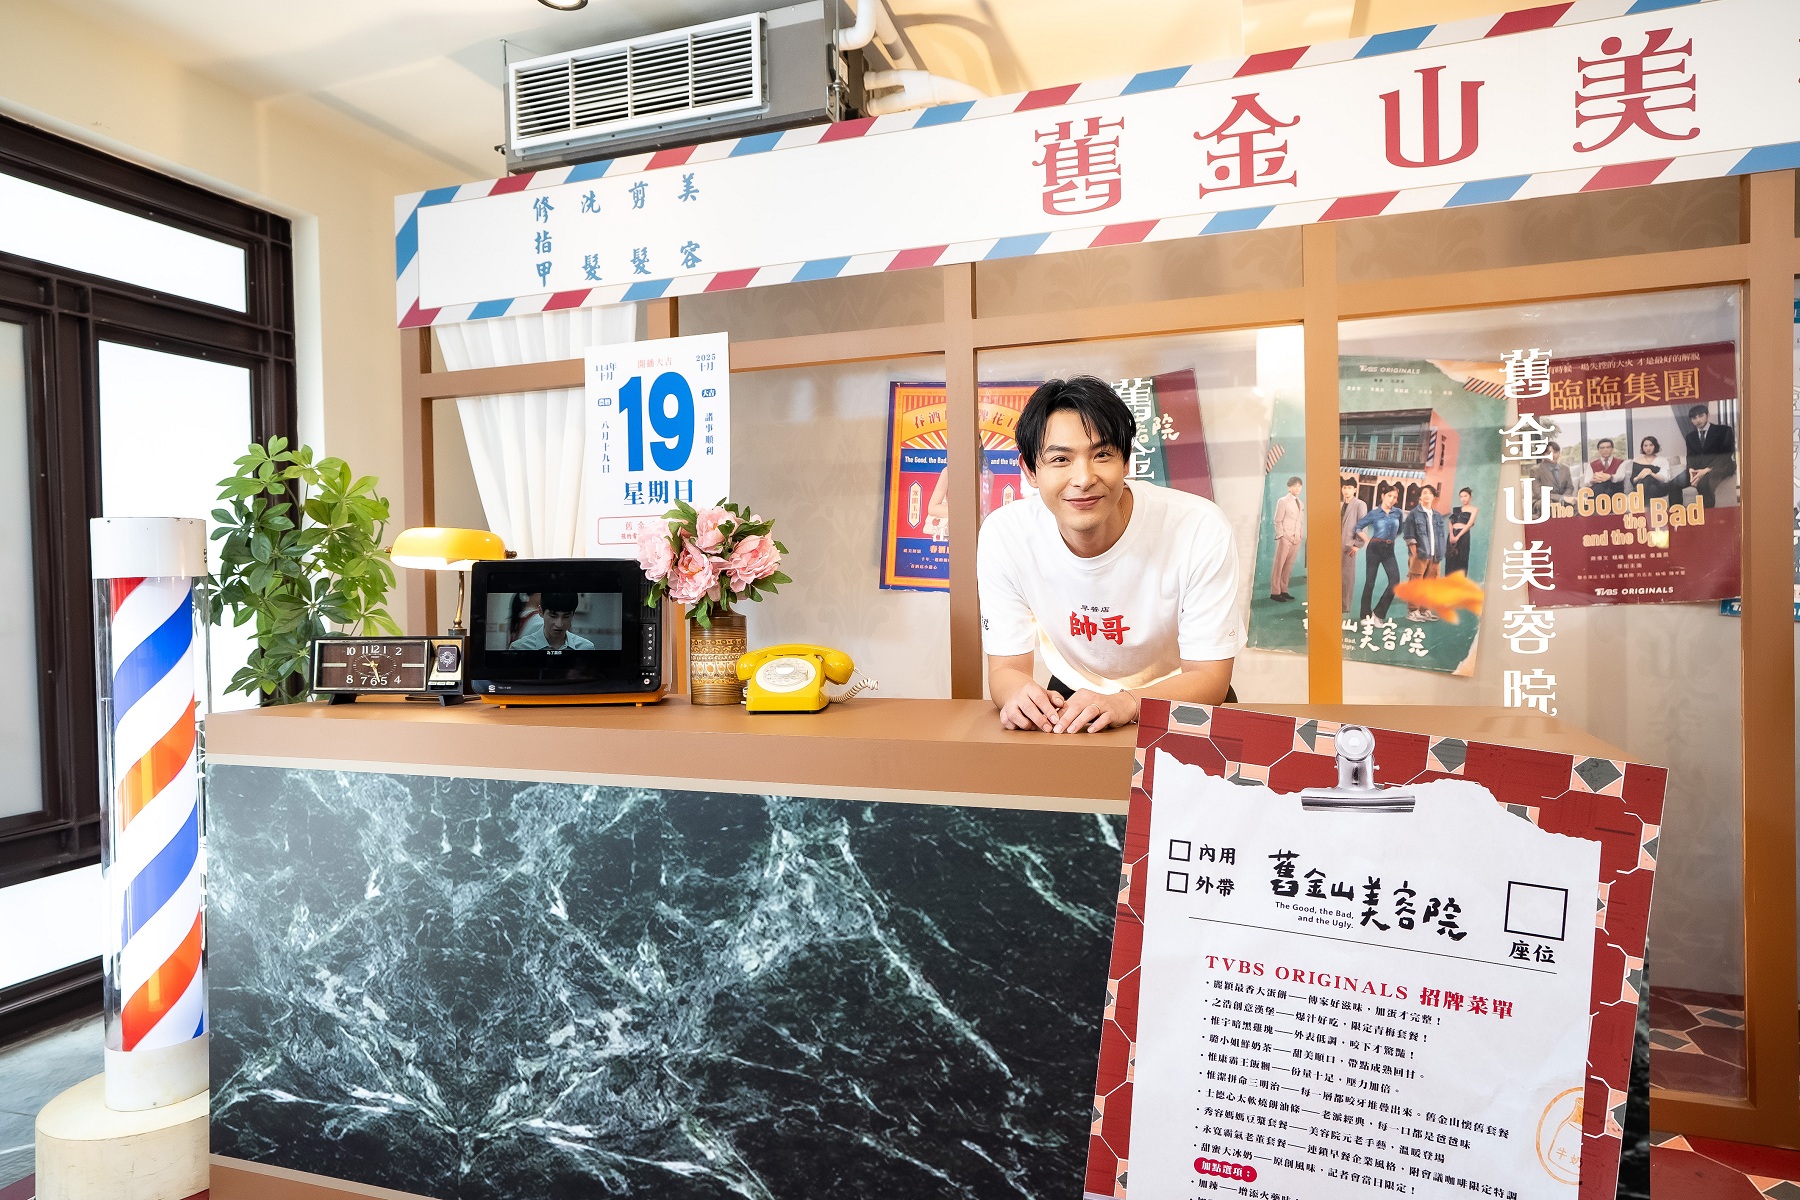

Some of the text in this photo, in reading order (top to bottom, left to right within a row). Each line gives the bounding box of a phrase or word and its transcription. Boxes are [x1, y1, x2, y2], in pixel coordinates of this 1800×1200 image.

[533, 196, 555, 288] 修指甲
[696, 353, 716, 362] 2025
[1380, 367, 1421, 375] ORIGINALS
[1550, 367, 1700, 411] 臨臨集團
[618, 371, 695, 472] 19
[704, 412, 714, 456] 諸事順利
[624, 479, 693, 505] 星期日
[1551, 483, 1645, 518] The Good
[1623, 495, 1705, 530] the Bad
[1498, 348, 1557, 717] 舊金山美容院
[1582, 530, 1609, 547] and
[1611, 528, 1634, 546] the
[1621, 586, 1674, 595] ORIGINALS
[1069, 611, 1130, 645] 帥哥
[346, 647, 356, 656] 10
[362, 645, 369, 654] 11
[370, 644, 380, 653] 12
[383, 645, 387, 654] 1
[395, 647, 402, 656] 2
[346, 675, 354, 684] 8
[360, 676, 368, 685] 7
[370, 676, 378, 686] 6
[380, 676, 388, 685] 5
[394, 675, 402, 684] 4
[1195, 875, 1235, 897] 外帶
[1268, 849, 1468, 941] 舊金山美容院
[1275, 901, 1354, 920] The Good, the Bad,
[1297, 914, 1354, 930] and the Ugly.
[1508, 940, 1556, 964] 座位
[1205, 954, 1513, 1020] TVBS ORIGINALS 招牌菜單
